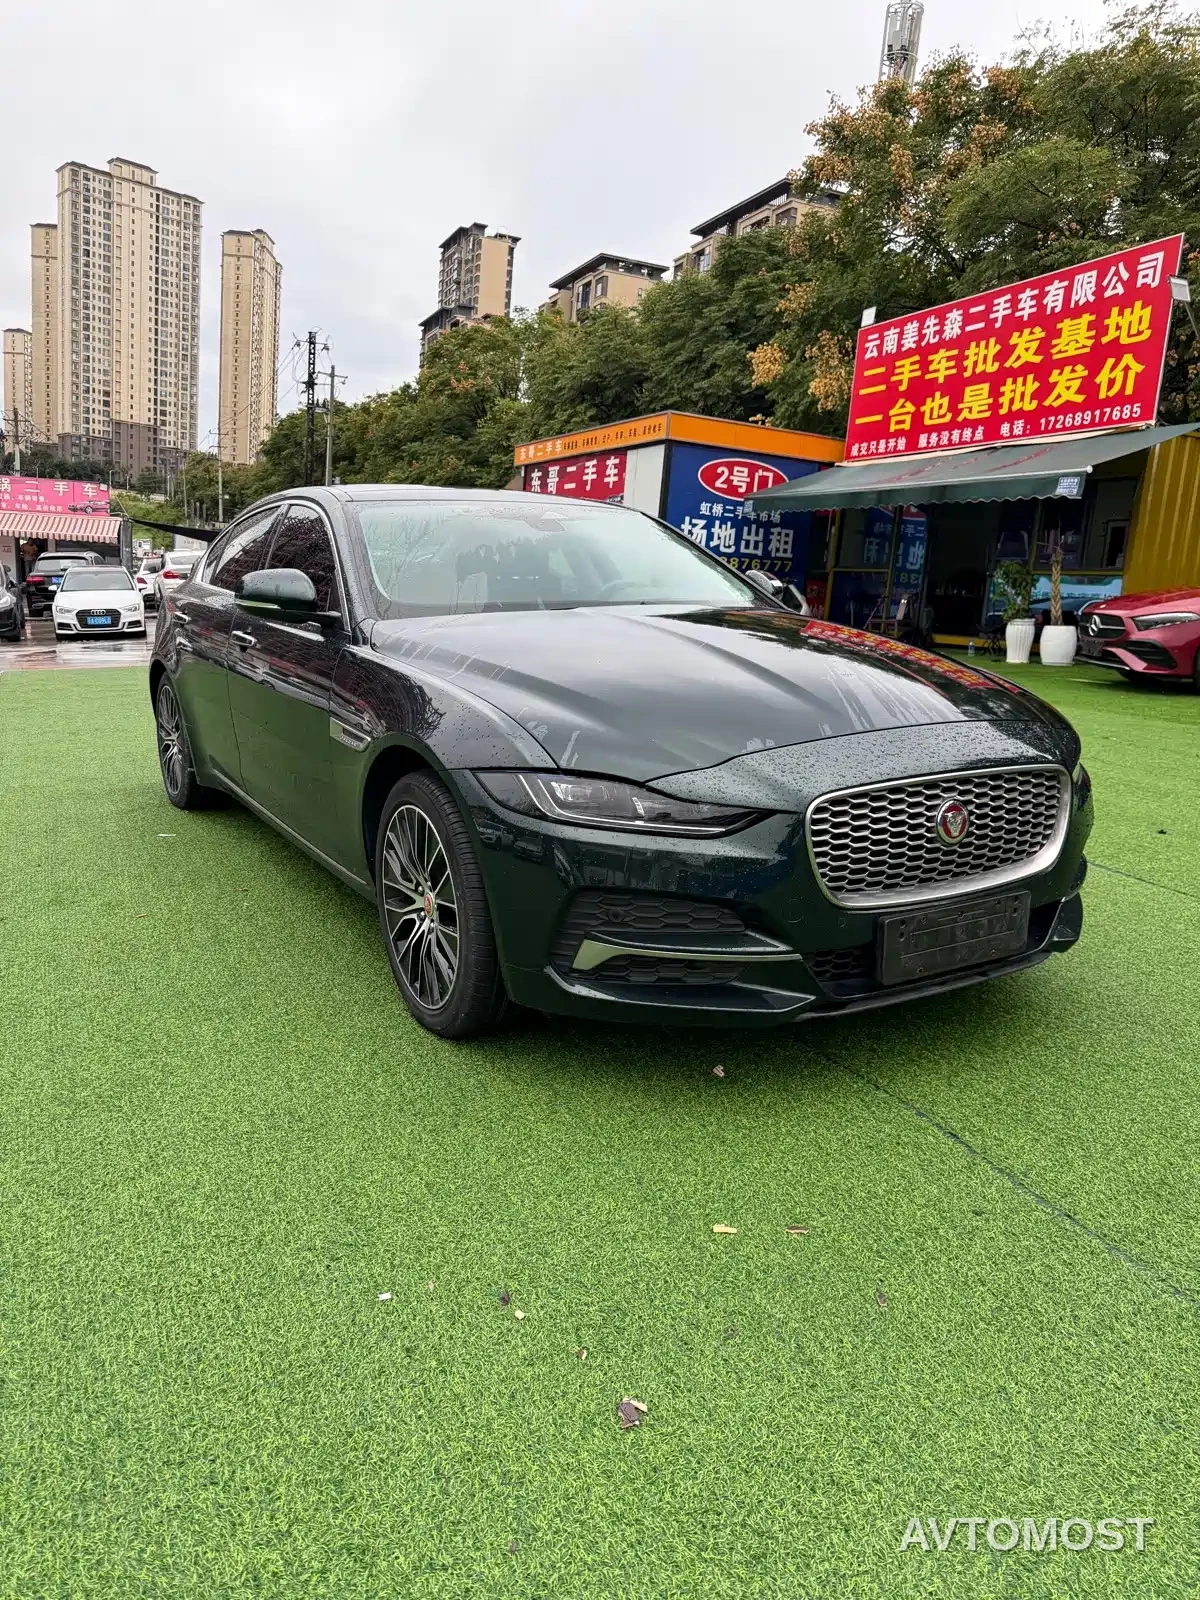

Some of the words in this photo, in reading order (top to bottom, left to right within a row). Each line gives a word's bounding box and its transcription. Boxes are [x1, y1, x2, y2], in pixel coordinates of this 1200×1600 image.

[864, 251, 1165, 361] 云南姜先森二手车有限公司
[858, 300, 1153, 395] 二手车批发基地
[855, 353, 1145, 433] 一台也是批发价
[850, 436, 907, 457] 成交只是开始
[918, 426, 985, 449] 服务没有终点
[1039, 403, 1142, 431] 17268917685
[531, 456, 620, 494] 东哥二手车
[714, 466, 774, 493] 2号门
[680, 516, 794, 559] 场地出租
